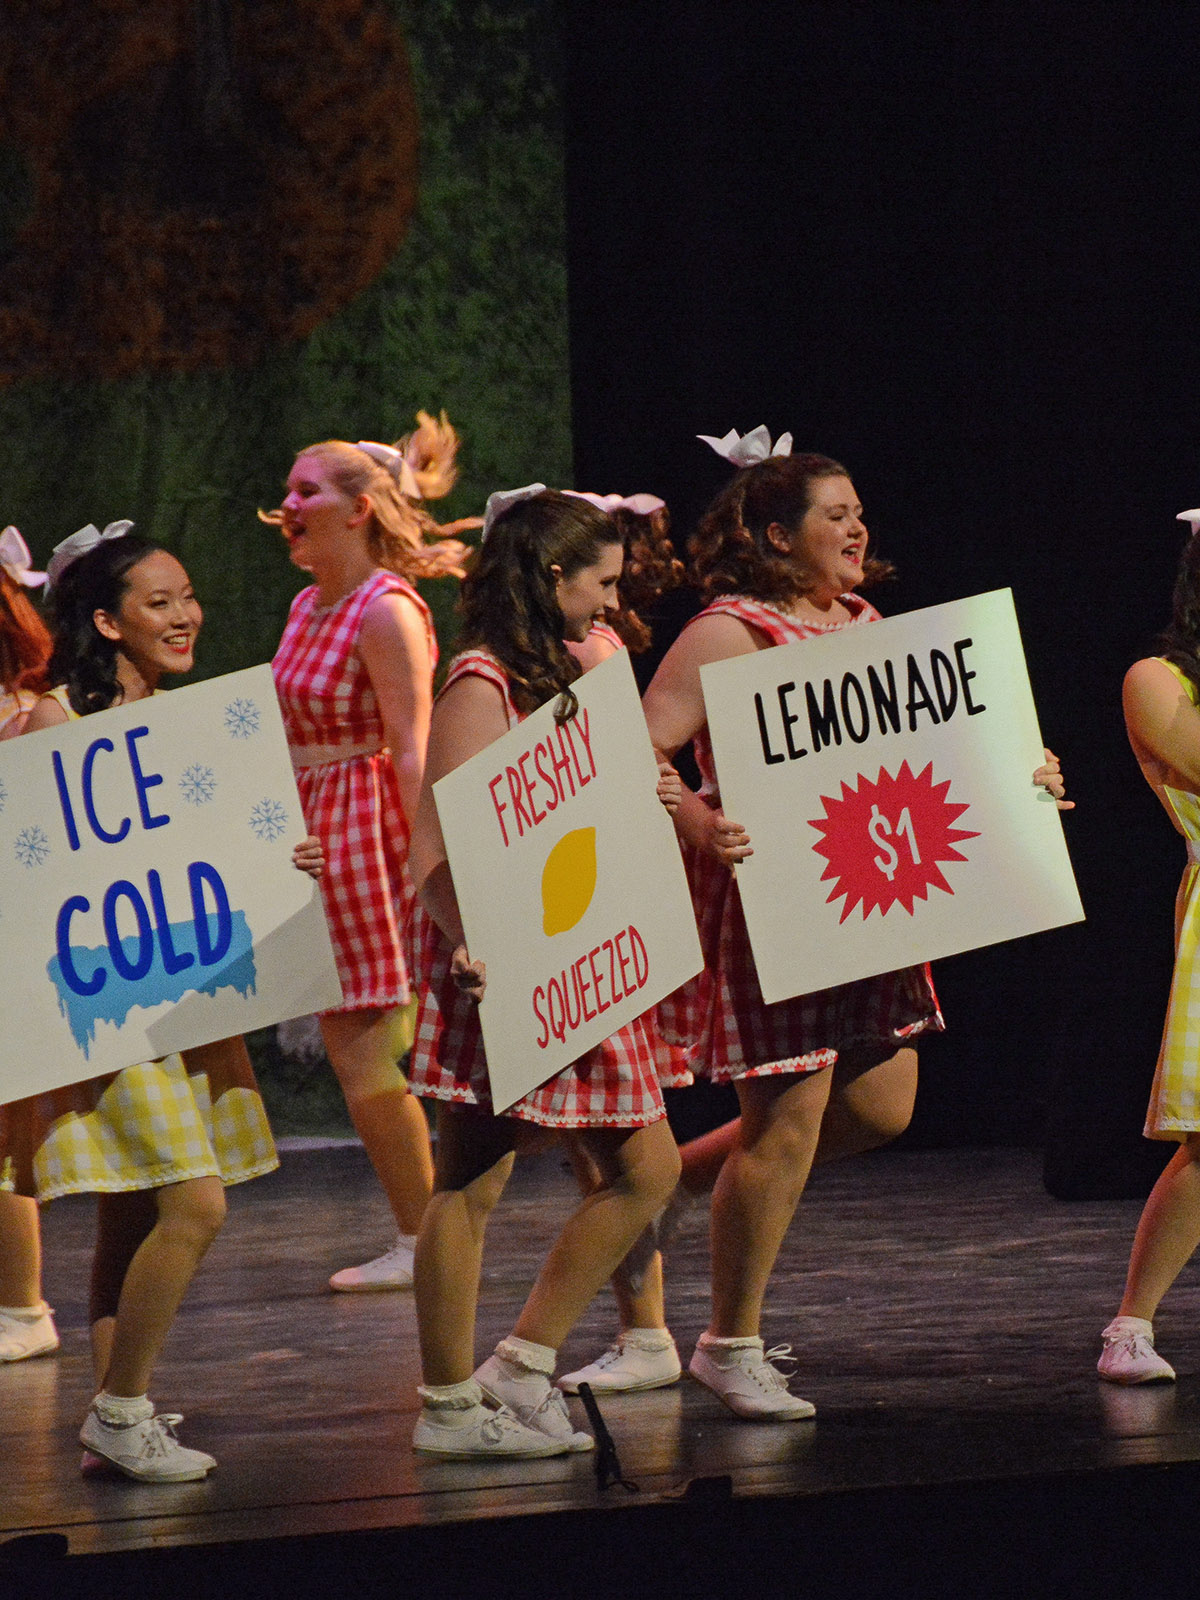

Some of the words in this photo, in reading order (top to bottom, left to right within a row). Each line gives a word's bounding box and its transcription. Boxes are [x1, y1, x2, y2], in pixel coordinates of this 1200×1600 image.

[754, 638, 986, 765] LEMONADE
[52, 725, 170, 851] ICE
[488, 707, 597, 847] FRESHLY
[867, 804, 922, 881] $1
[56, 861, 233, 996] COLD
[532, 925, 649, 1049] SQUEEZED
